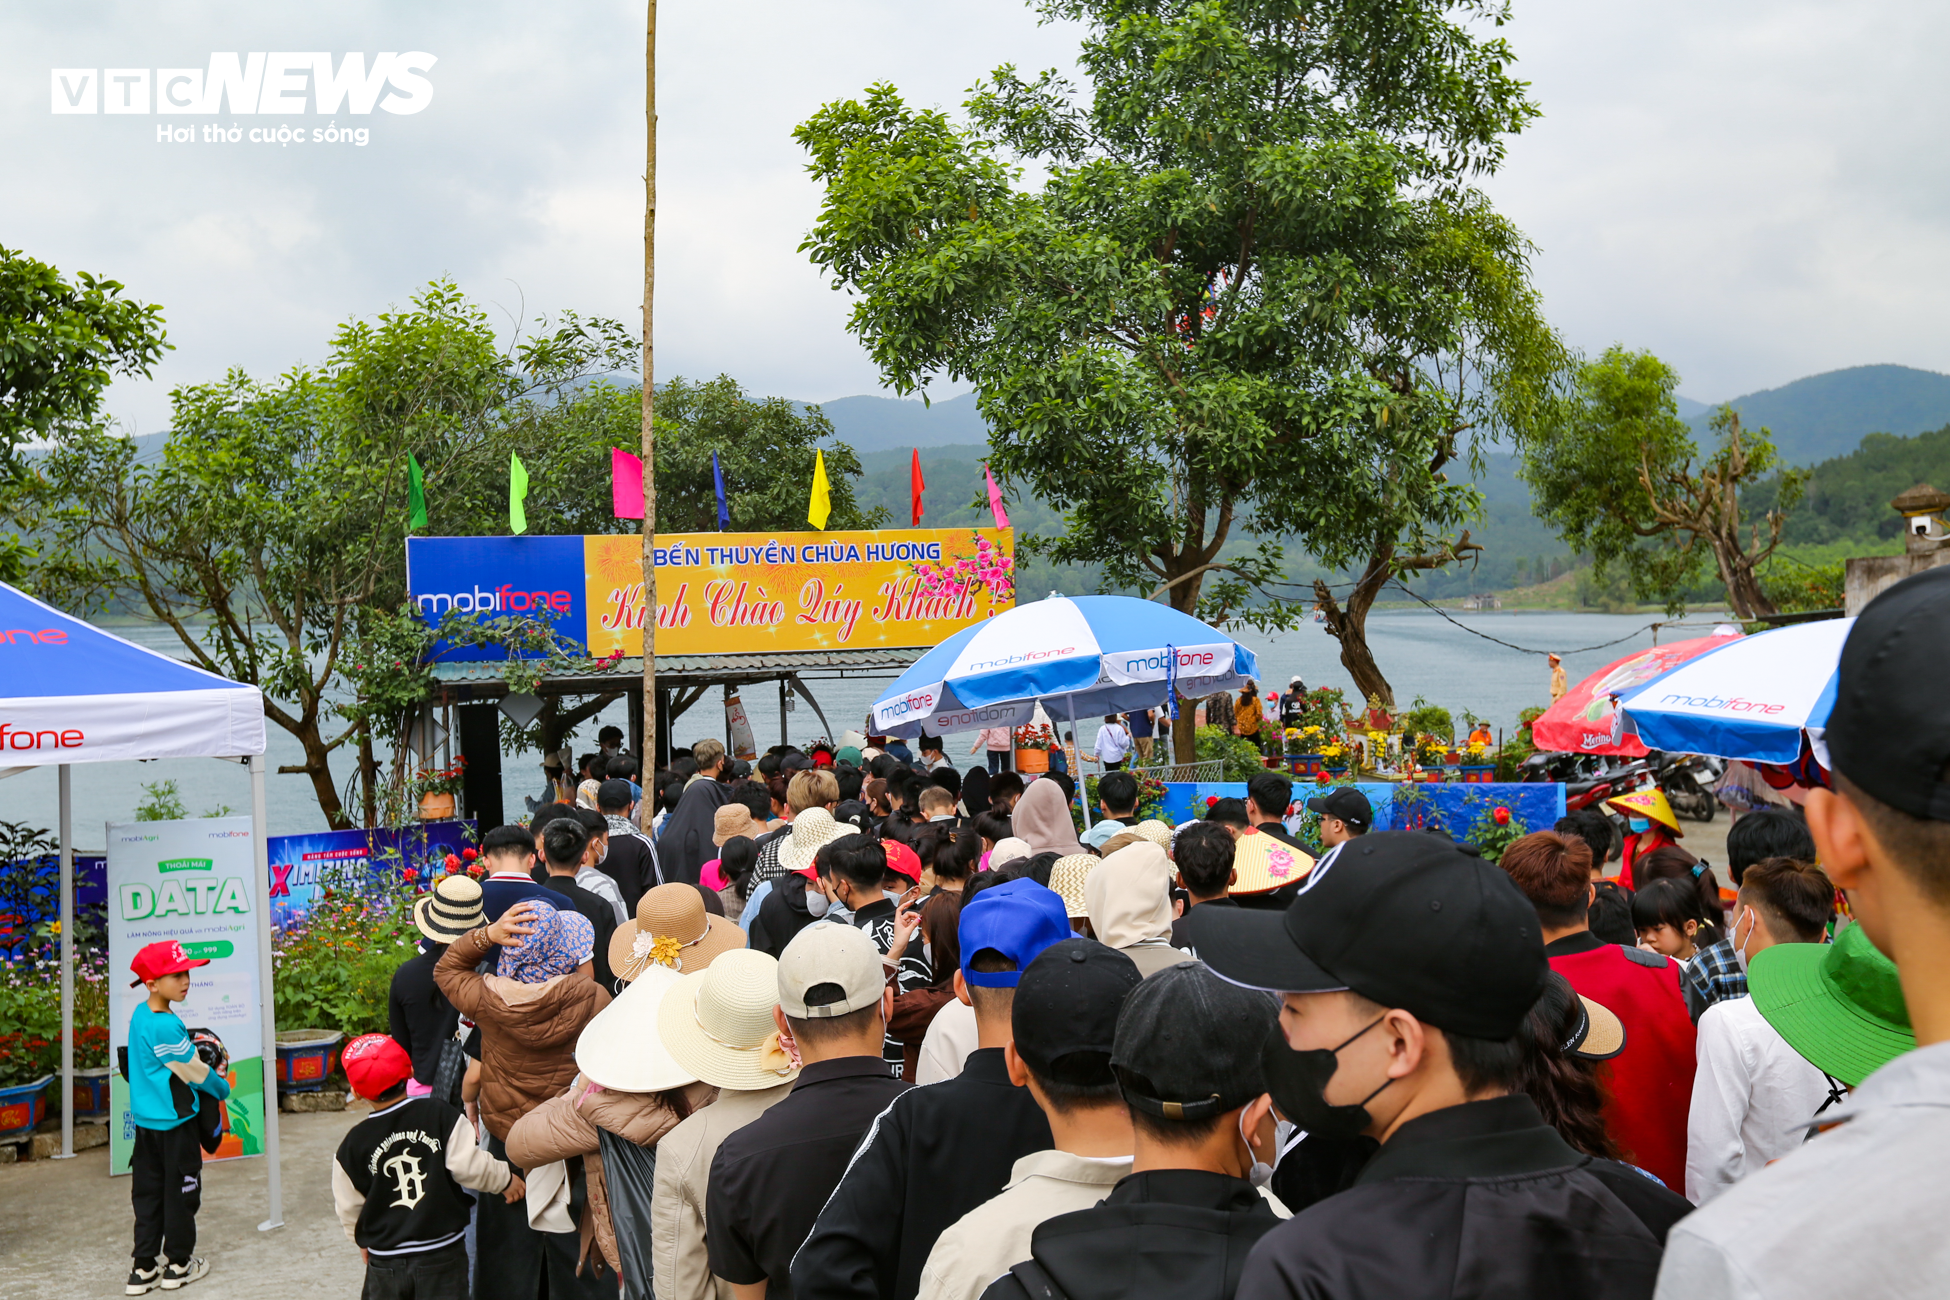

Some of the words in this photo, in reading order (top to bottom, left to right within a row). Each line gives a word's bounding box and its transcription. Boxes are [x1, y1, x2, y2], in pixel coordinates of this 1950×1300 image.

[653, 541, 700, 567] BẾN
[705, 539, 796, 565] THUYỀN
[801, 540, 862, 564] CHÙA
[866, 541, 941, 562] HƯƠNG
[418, 584, 572, 613] mobifone
[703, 579, 785, 627] Chào
[970, 646, 1076, 671] mobifone
[881, 694, 933, 721] mobifone
[1660, 694, 1785, 715] mobifone
[1582, 732, 1613, 746] Merino
[208, 830, 250, 839] mobifone
[119, 877, 251, 921] DATA
[127, 931, 141, 939] LÀM
[142, 930, 162, 938] NÔNG
